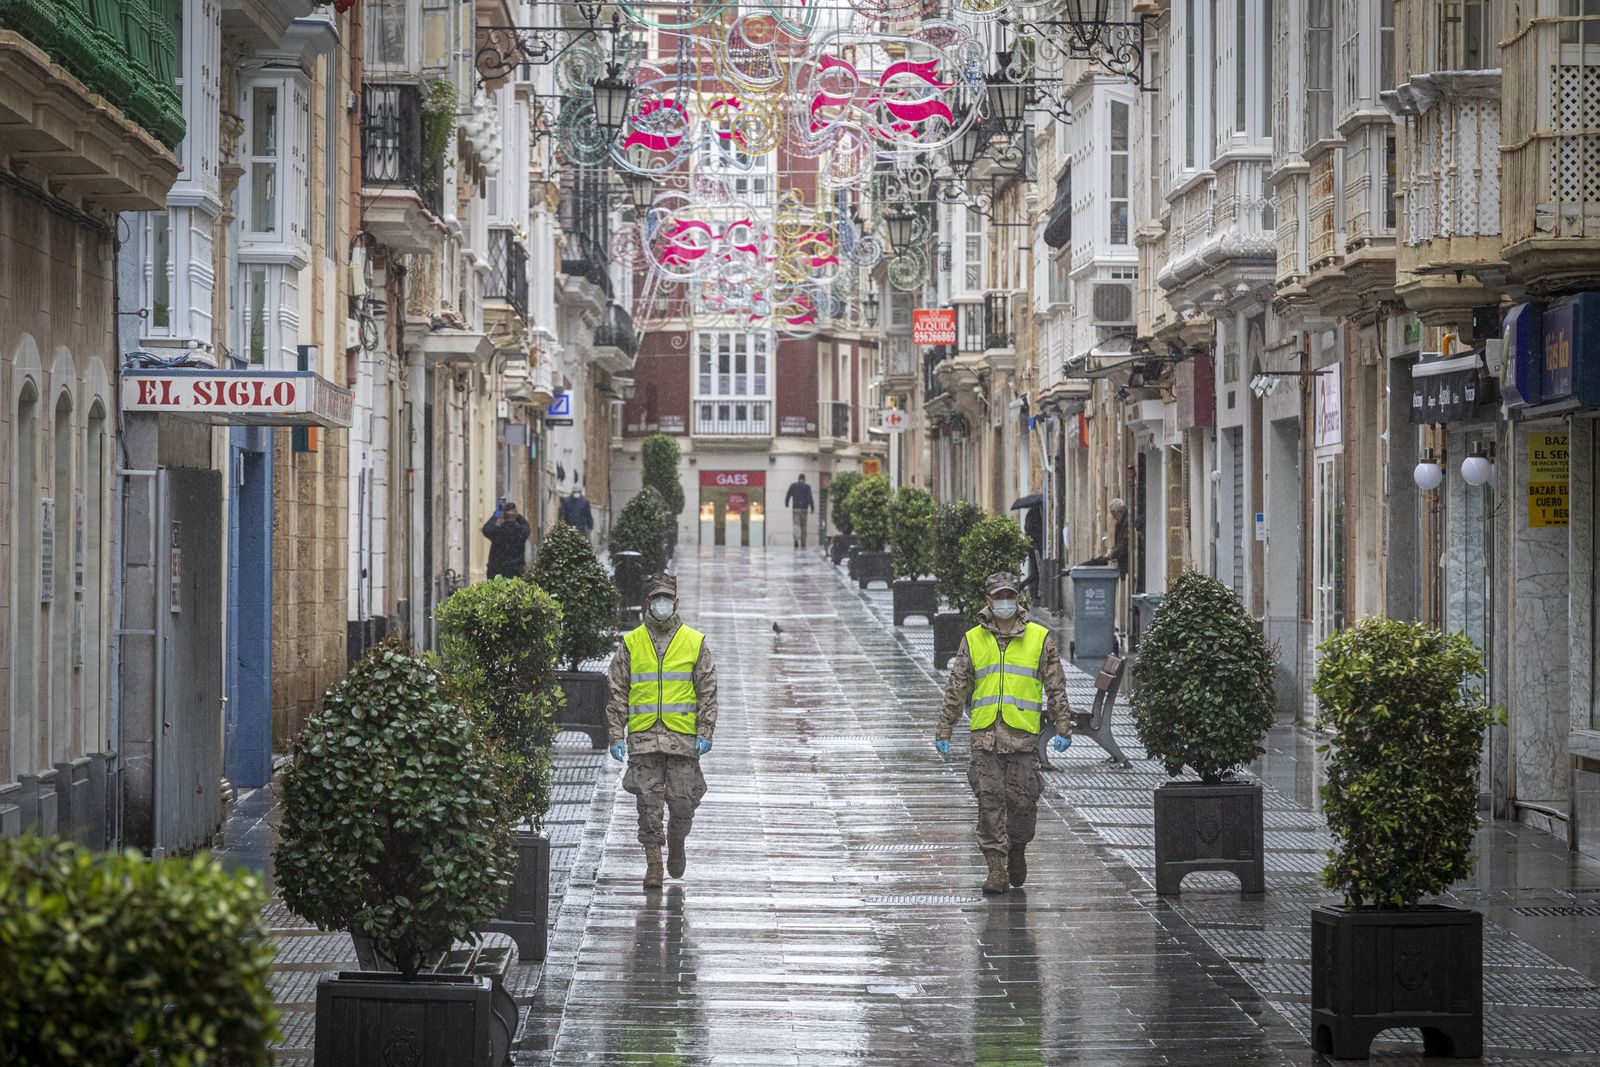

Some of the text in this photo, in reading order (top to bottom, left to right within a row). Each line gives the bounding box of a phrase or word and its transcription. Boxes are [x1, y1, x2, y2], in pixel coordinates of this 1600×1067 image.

[914, 322, 956, 331] ALQUILA
[137, 380, 180, 405] EL
[193, 381, 295, 406] SIGLO
[1545, 436, 1569, 445] BAZ
[1534, 450, 1547, 459] EL
[716, 474, 749, 485] GAES
[1529, 486, 1568, 495] BAZAR EL
[1536, 497, 1562, 507] CUERO
[1542, 509, 1546, 518] Y
